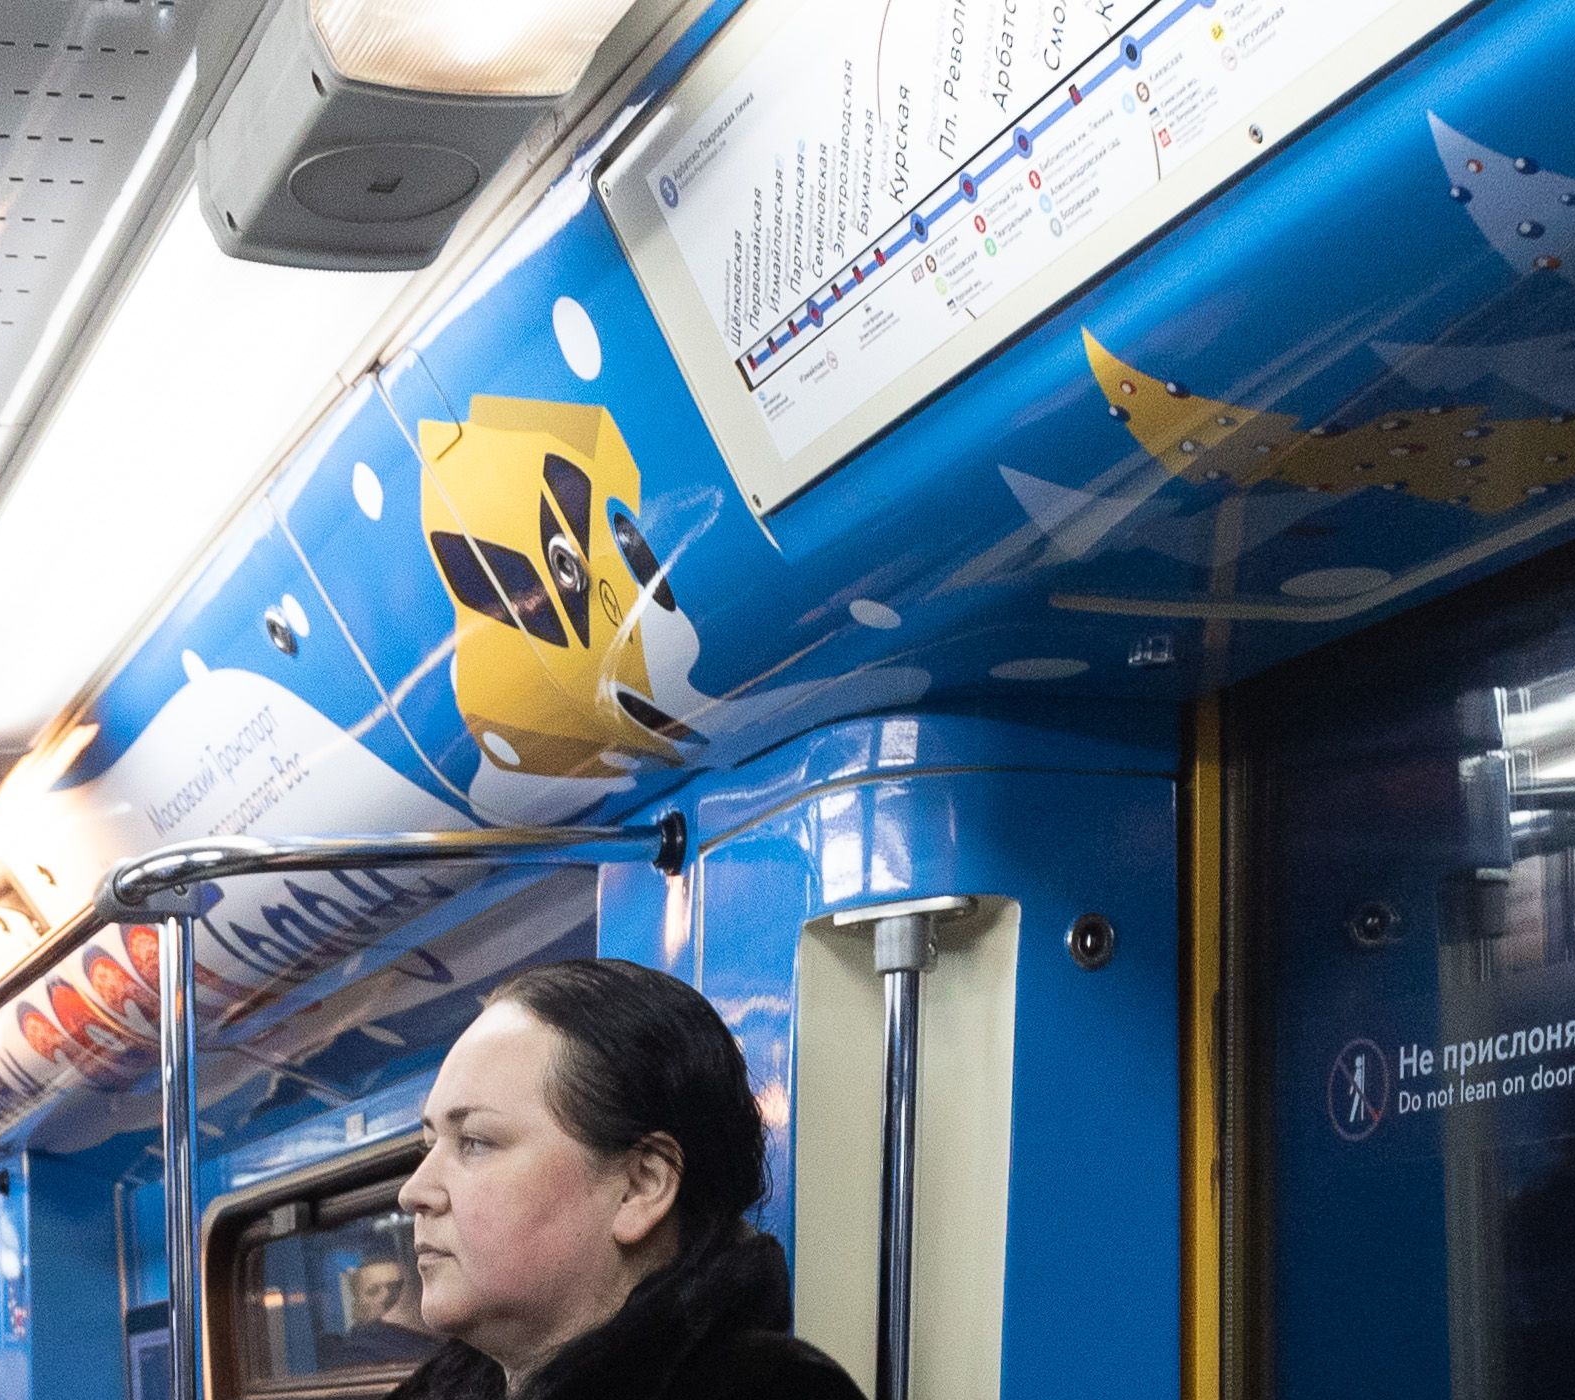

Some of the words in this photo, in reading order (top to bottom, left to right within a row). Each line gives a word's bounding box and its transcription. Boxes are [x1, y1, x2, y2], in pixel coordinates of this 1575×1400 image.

[833, 59, 853, 259] Электрозаводская
[857, 108, 875, 236] Бауманская
[889, 85, 910, 204] Курская
[938, 113, 959, 160] Пл.
[749, 187, 763, 332] Первомайская
[769, 168, 784, 314] Измайловская
[789, 153, 805, 295] Партизанская
[811, 143, 828, 279] Семёновская
[730, 230, 743, 347] Щёлковская
[145, 758, 219, 838] Московский
[205, 705, 279, 785] Транспорт
[269, 752, 310, 790] Вас
[1398, 1044, 1435, 1079] Не
[1398, 1089, 1422, 1114] Do
[1427, 1084, 1455, 1109] not
[1460, 1077, 1498, 1105] lean
[1502, 1073, 1526, 1096] on
